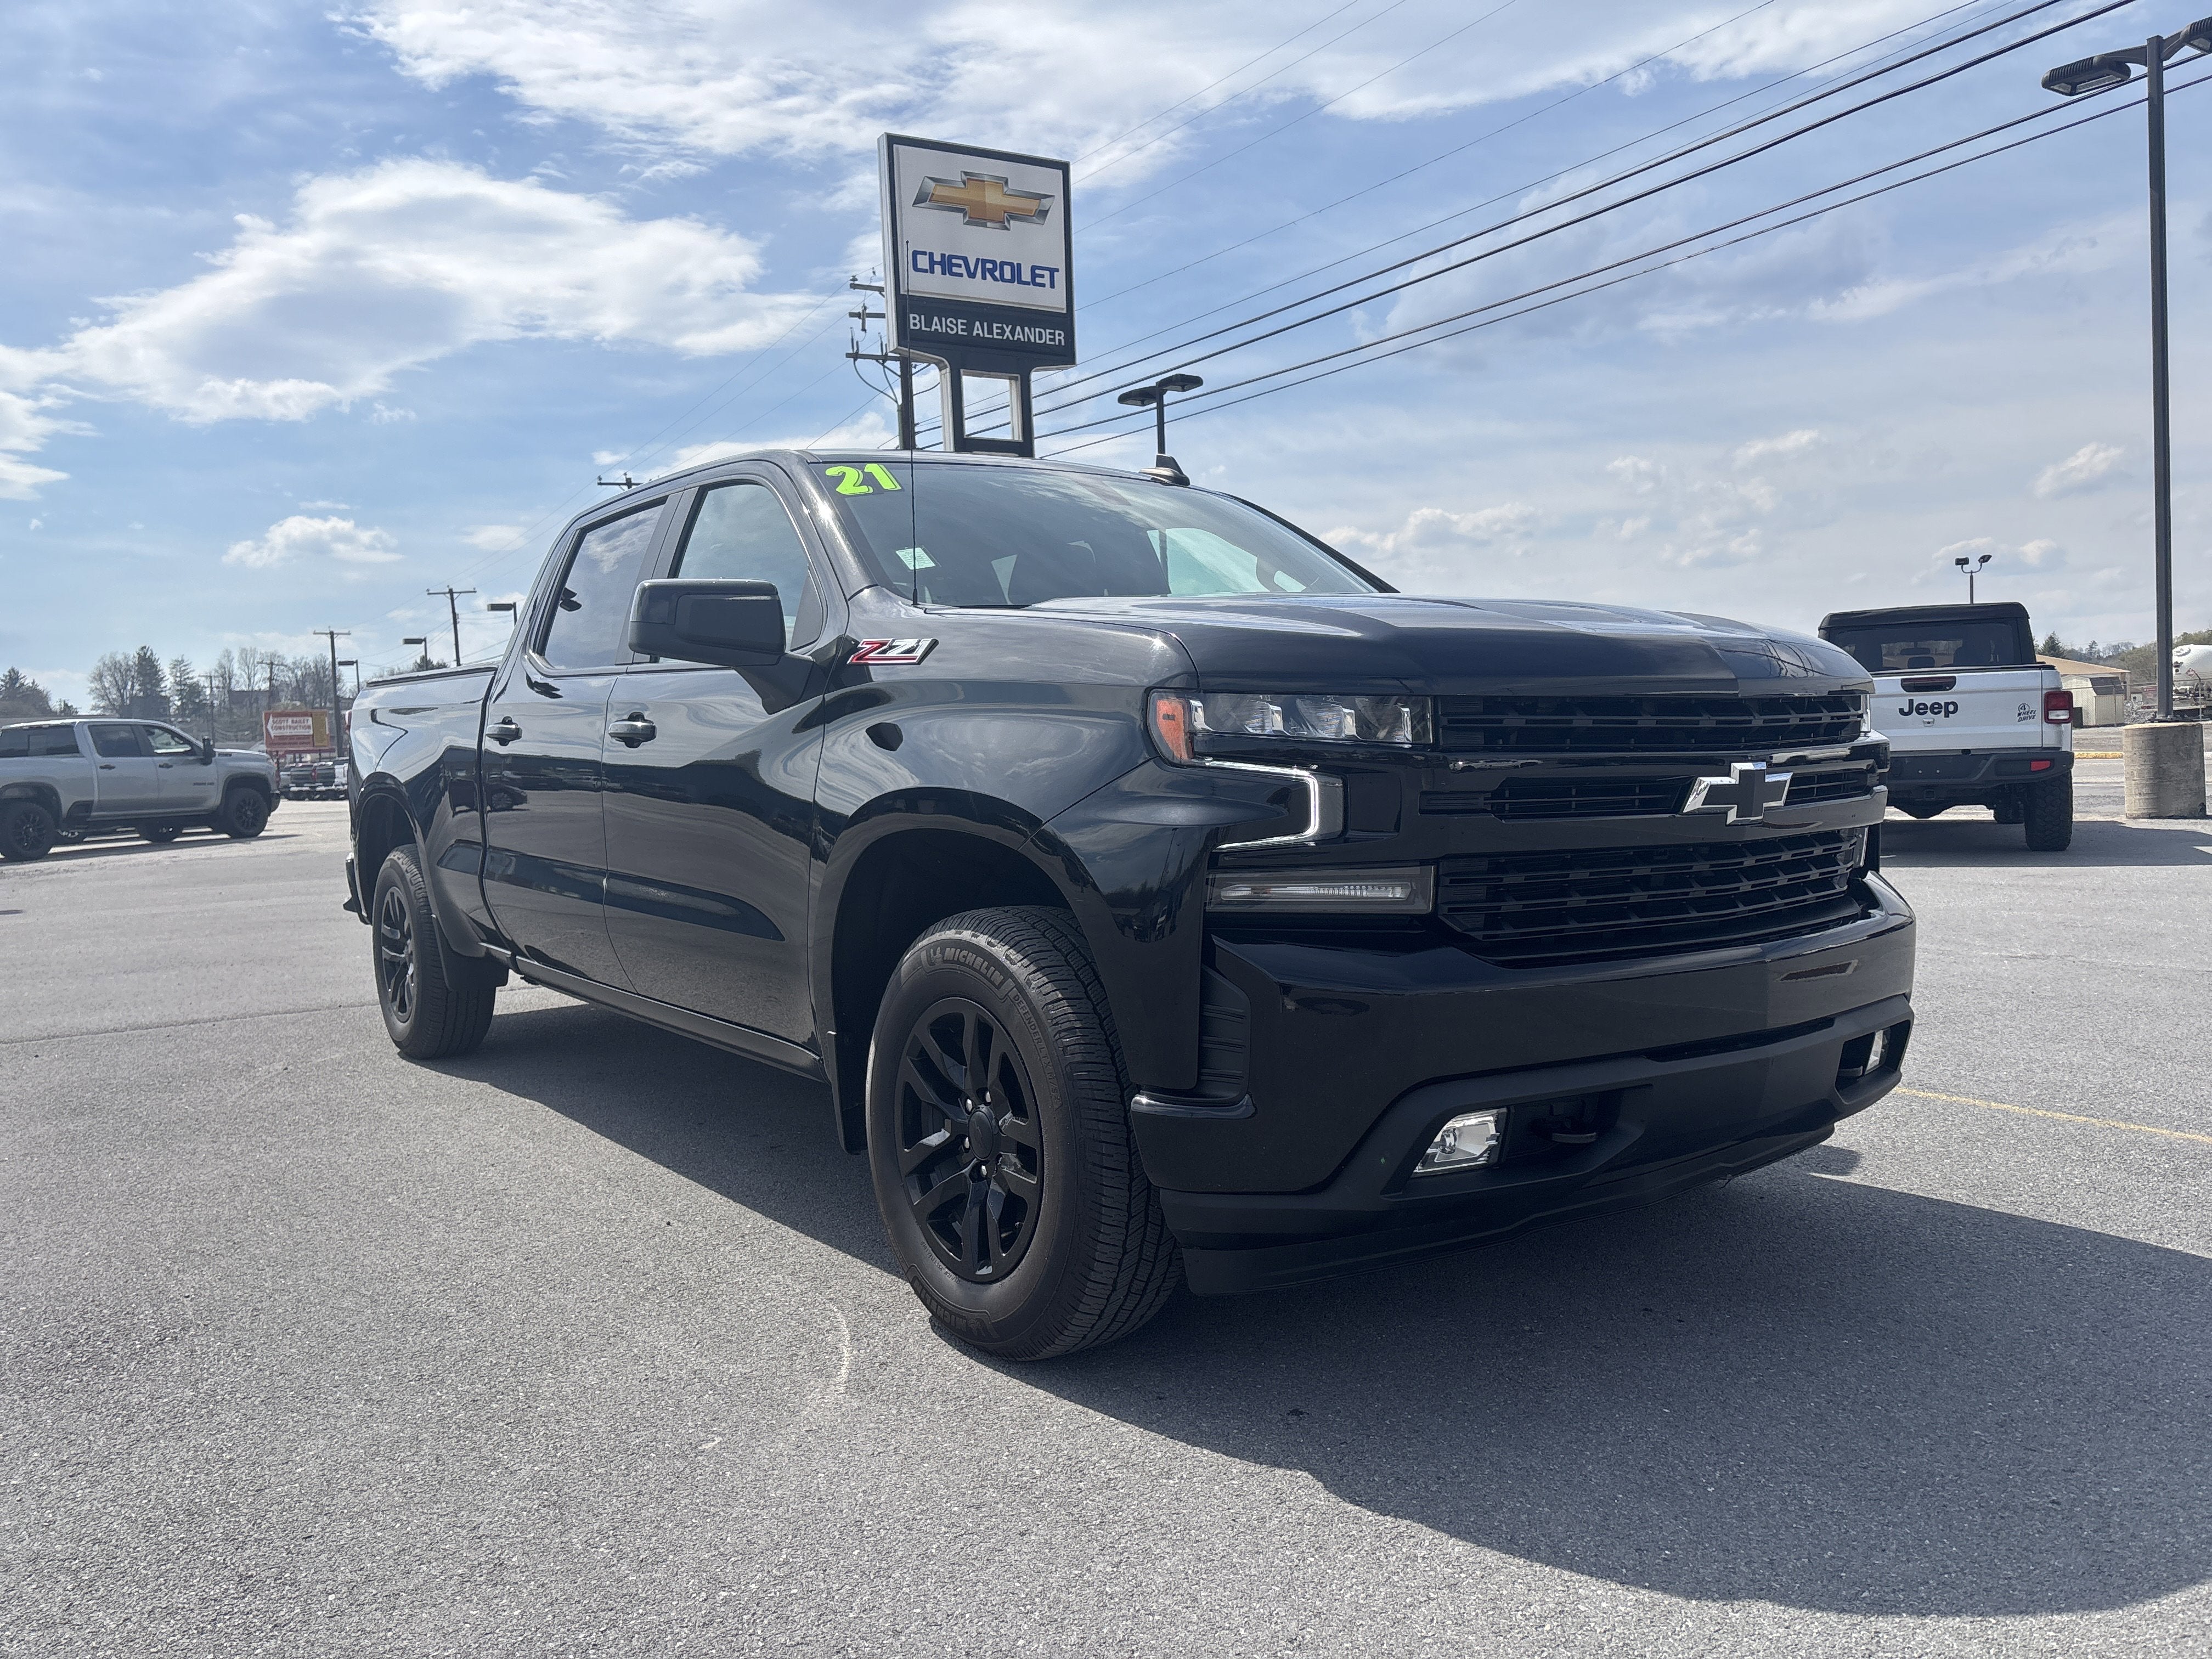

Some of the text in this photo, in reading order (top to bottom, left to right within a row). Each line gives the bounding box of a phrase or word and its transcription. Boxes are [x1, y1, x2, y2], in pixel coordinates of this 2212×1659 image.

[912, 250, 1059, 289] CHEVROLET
[910, 313, 1065, 346] BLAISE ALEXANDER
[825, 463, 902, 495] 21
[847, 638, 934, 665] Z71
[1898, 698, 1959, 718] Jeep
[2017, 714, 2036, 723] DRIVE
[943, 947, 1004, 986] MICHELIN
[1013, 994, 1042, 1044] DEFENDER
[1040, 1047, 1052, 1069] LTX
[913, 1278, 967, 1332] MICHELIN
